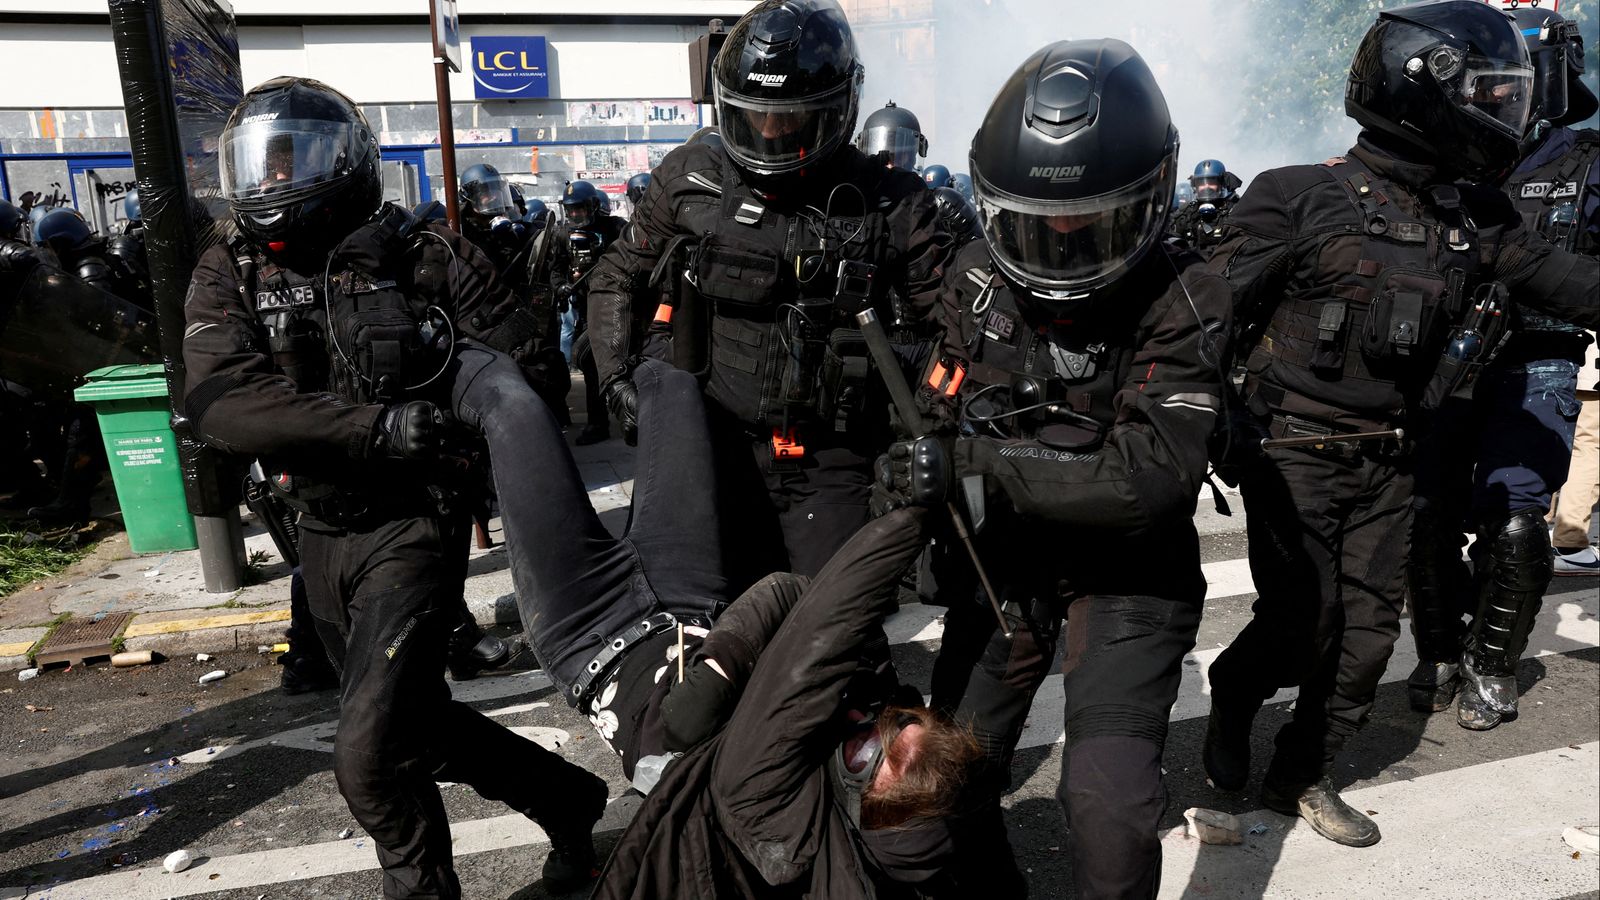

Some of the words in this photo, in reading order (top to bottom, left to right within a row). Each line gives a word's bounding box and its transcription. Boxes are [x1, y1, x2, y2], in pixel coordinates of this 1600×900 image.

[478, 51, 539, 71] LCL
[747, 72, 788, 88] NOLAN
[241, 112, 280, 126] NOLAN
[1029, 164, 1087, 184] NOLAN
[1523, 183, 1574, 196] POCE
[258, 286, 313, 309] POCE
